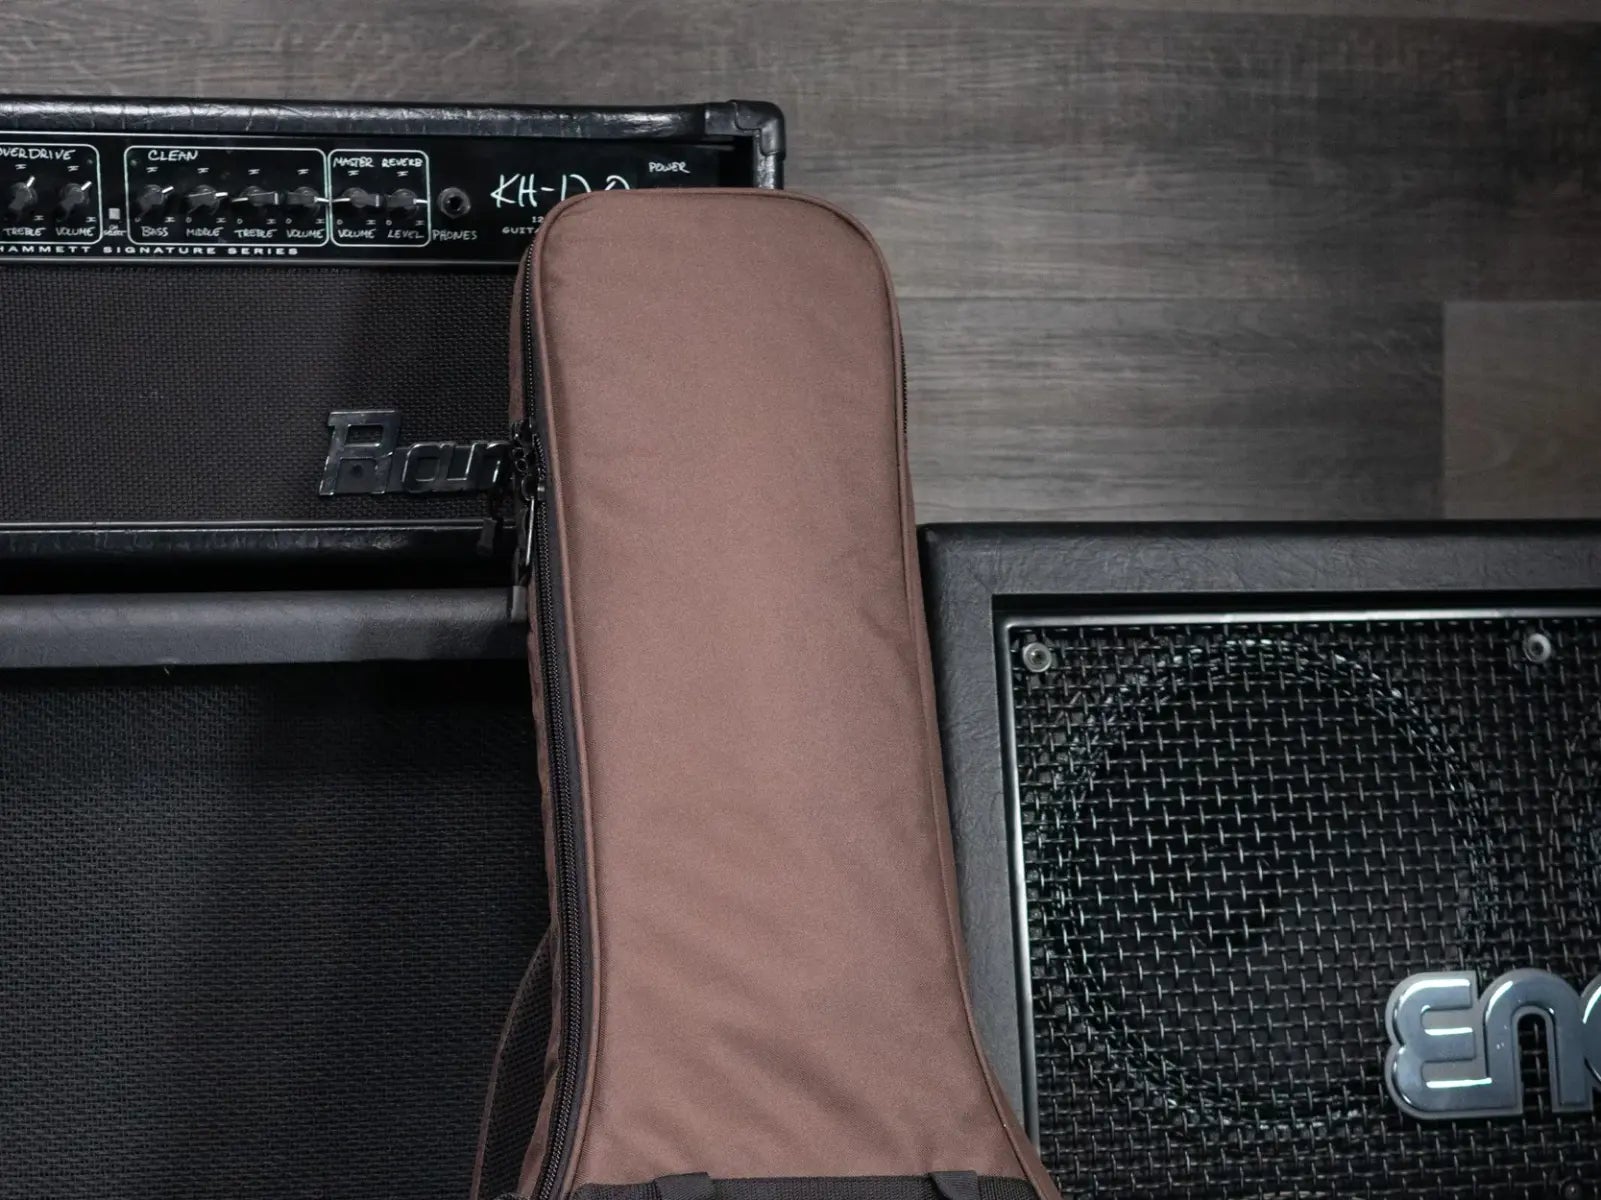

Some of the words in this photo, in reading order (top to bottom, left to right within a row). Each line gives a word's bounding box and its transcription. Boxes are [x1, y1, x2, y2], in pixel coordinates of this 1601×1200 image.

[0, 147, 76, 160] VERDRIVE
[148, 149, 199, 161] CLEAN
[333, 156, 375, 168] MASTER
[381, 157, 424, 168] REVERB
[648, 162, 691, 174] POWER
[2, 227, 47, 237] TREBLE
[55, 226, 96, 237] VOLUME
[141, 226, 169, 237] BASS
[234, 228, 278, 239] TREBLE
[286, 228, 325, 239] VOLUME
[338, 229, 376, 239] VOLUME
[387, 230, 425, 239] LEVEL
[432, 230, 478, 241] PHONES
[103, 246, 216, 254] SIGNATURE
[227, 247, 298, 255] SERIES
